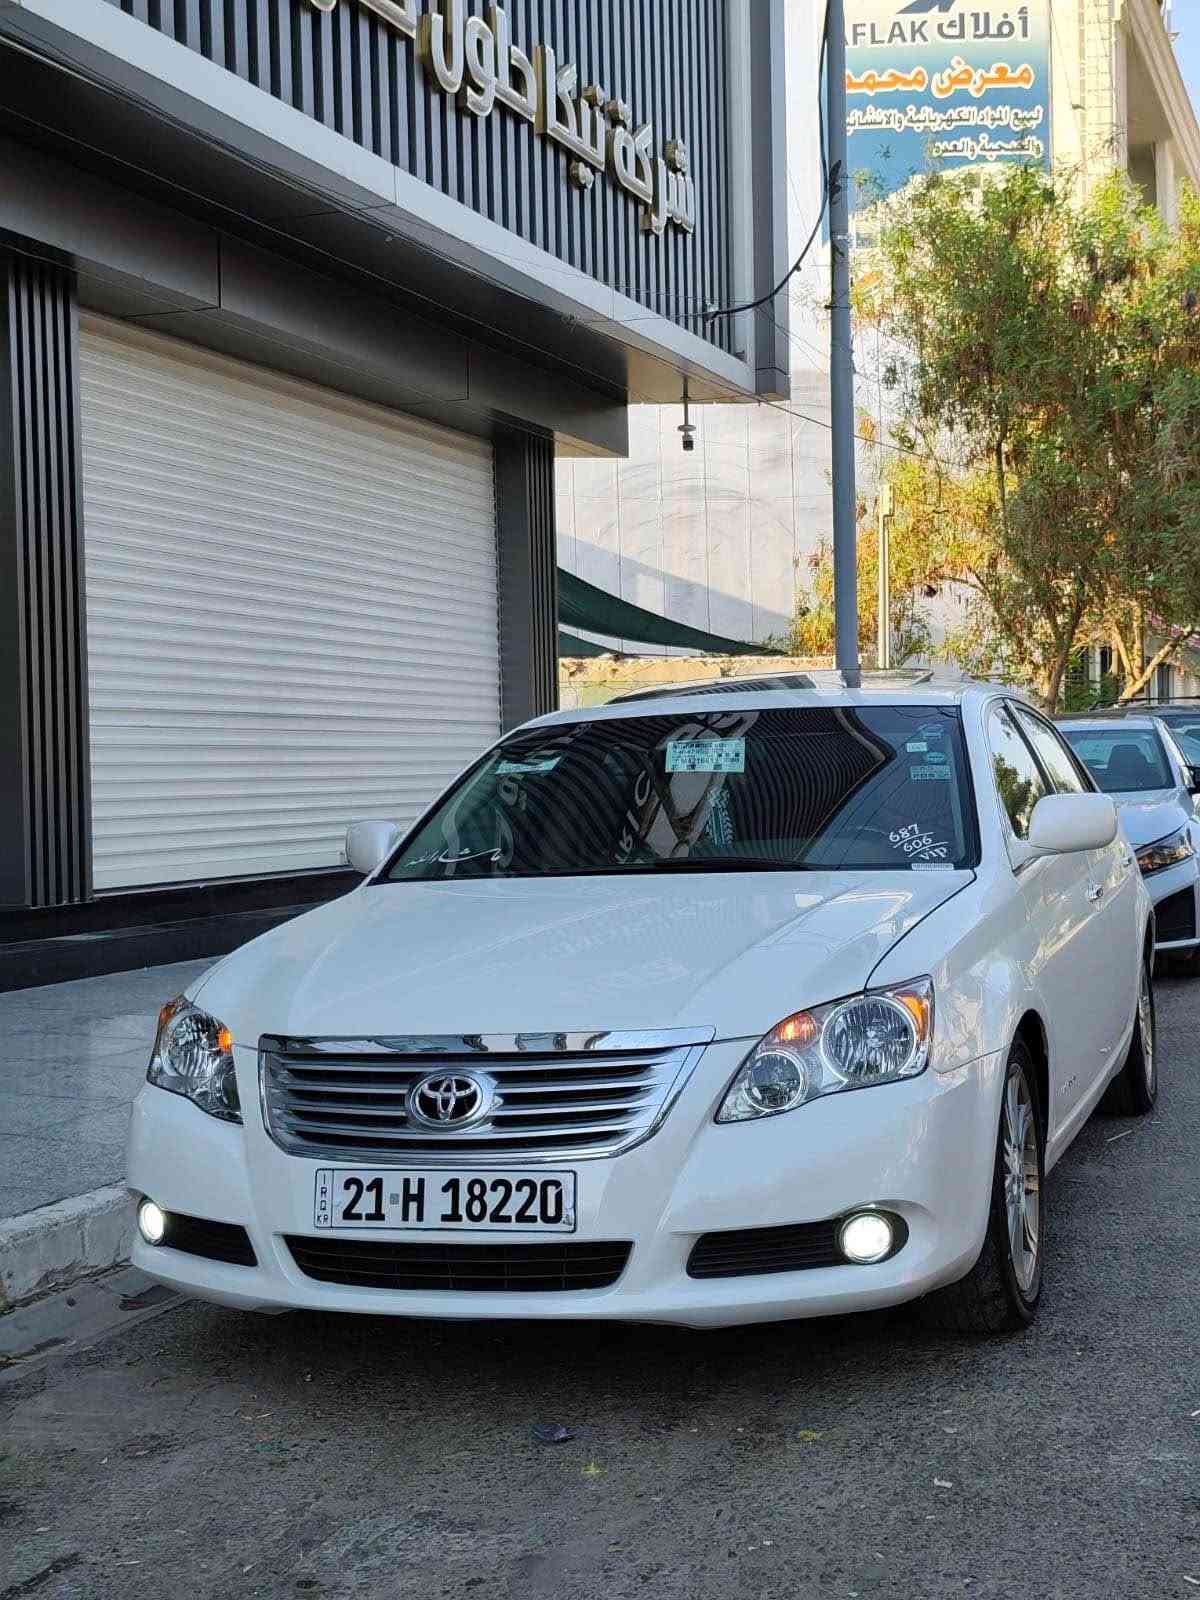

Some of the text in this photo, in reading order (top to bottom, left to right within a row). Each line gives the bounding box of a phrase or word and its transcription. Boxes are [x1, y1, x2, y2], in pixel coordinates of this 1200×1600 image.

[845, 19, 929, 46] FLAK
[936, 6, 1029, 40] أفلاك
[932, 56, 1035, 98] معرض
[607, 98, 695, 235] شركة
[889, 823, 919, 842] 687
[903, 835, 933, 852] 606
[342, 1177, 563, 1224] 21 H 18220
